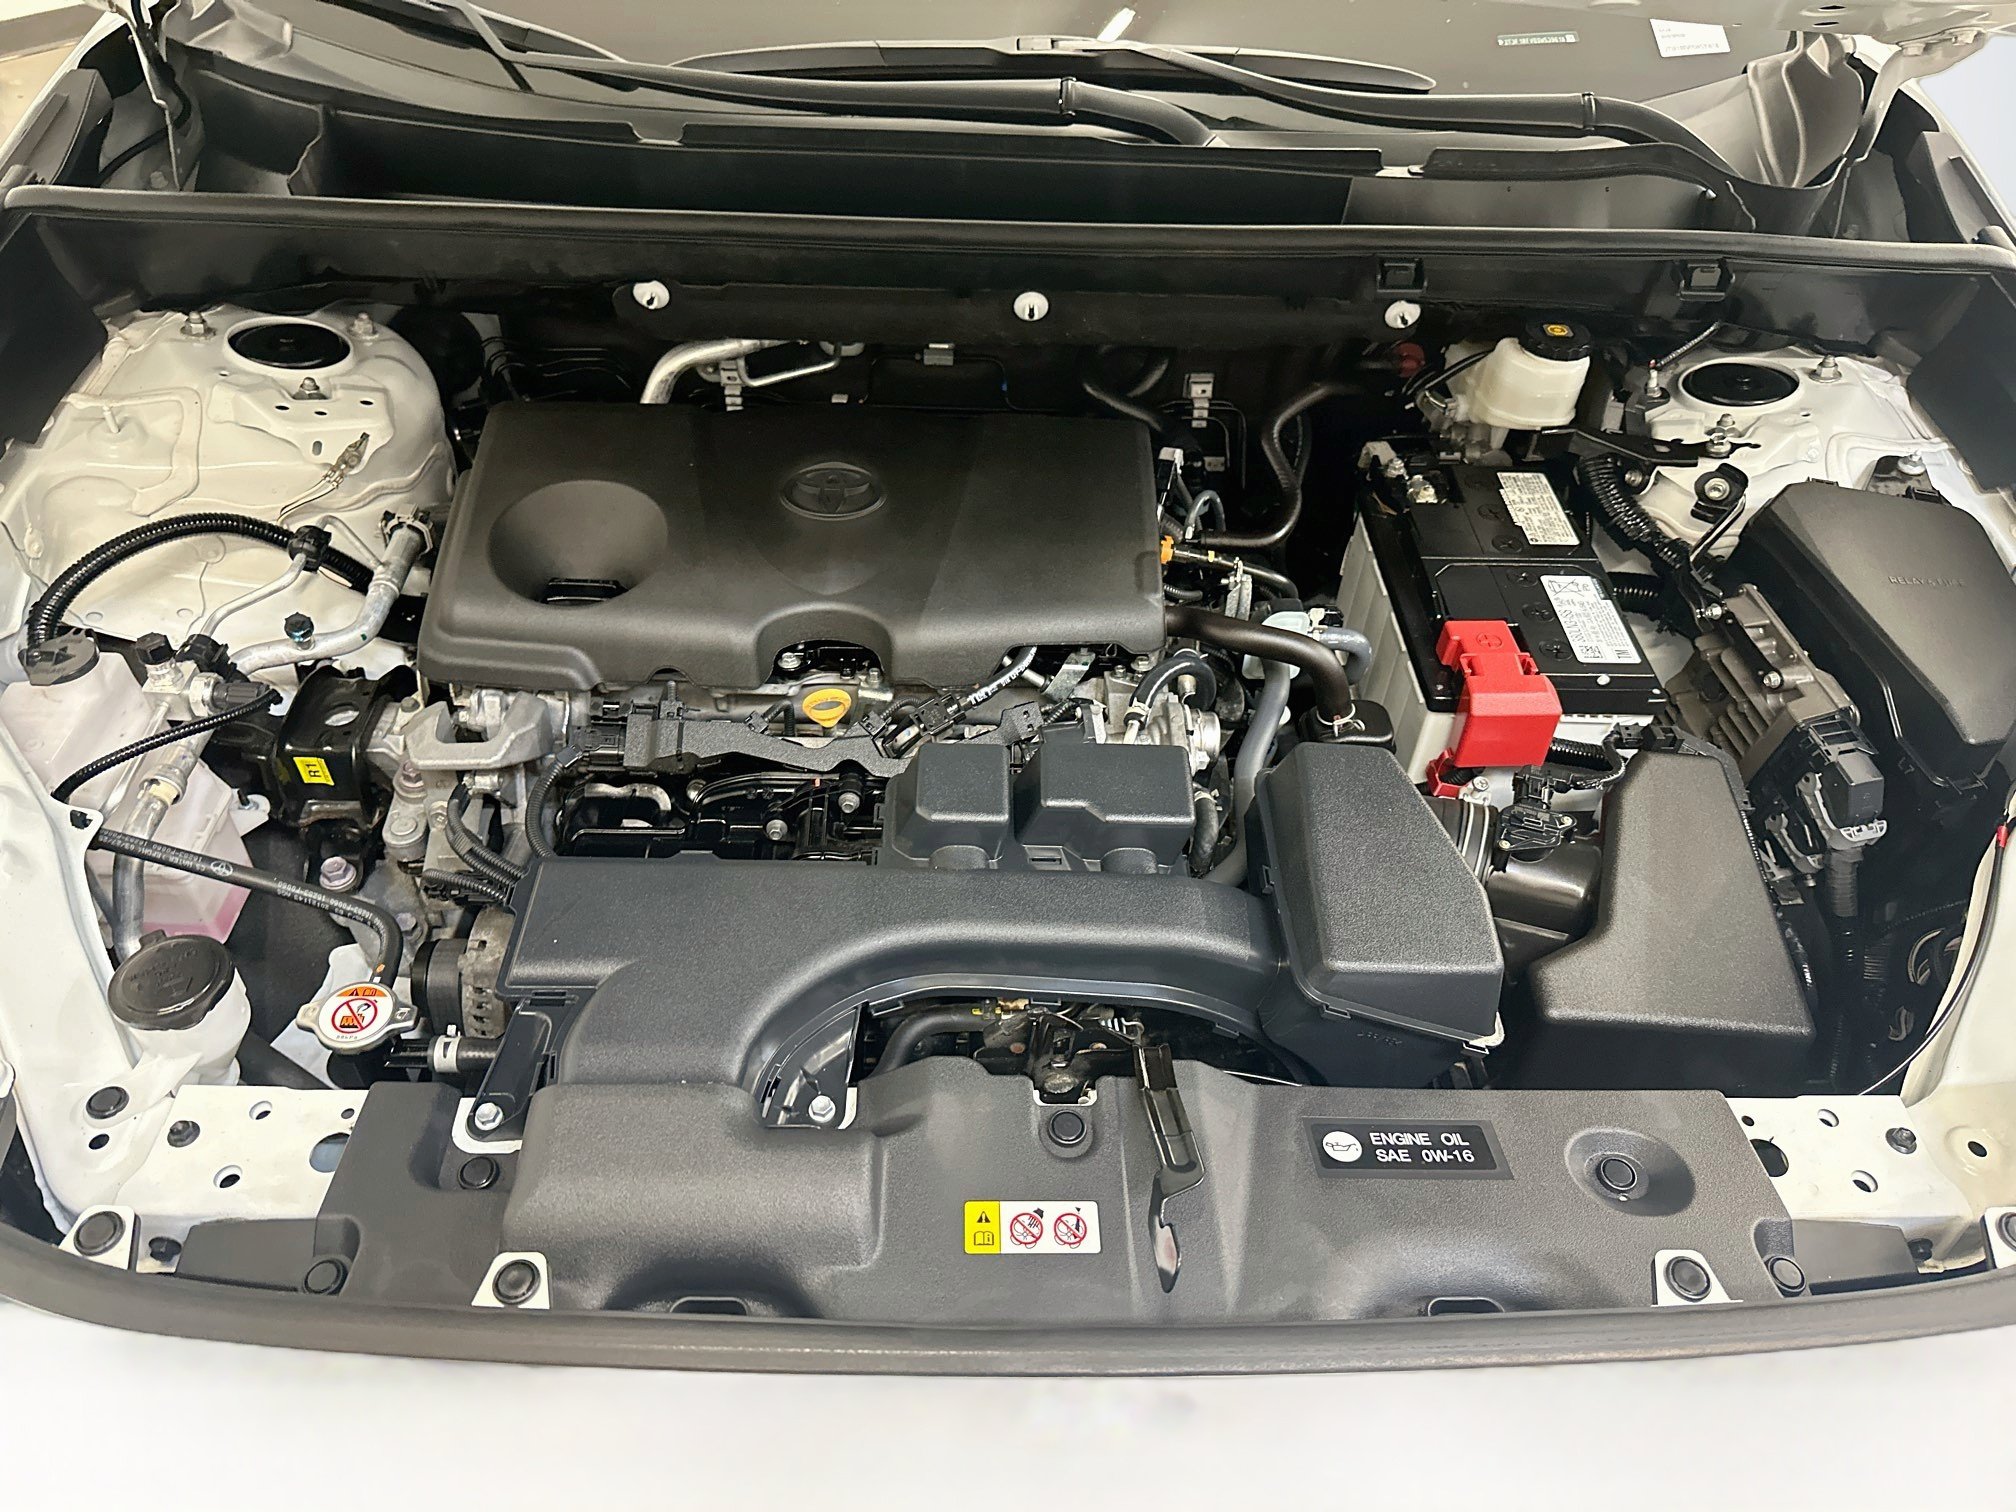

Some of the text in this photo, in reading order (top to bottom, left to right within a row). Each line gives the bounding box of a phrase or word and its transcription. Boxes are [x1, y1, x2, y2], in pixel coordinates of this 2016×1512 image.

[1888, 576, 1925, 585] RELAY
[305, 764, 321, 777] R1
[1369, 1132, 1470, 1146] ENGINE OIL
[1375, 1149, 1474, 1163] SAE 0W-16
